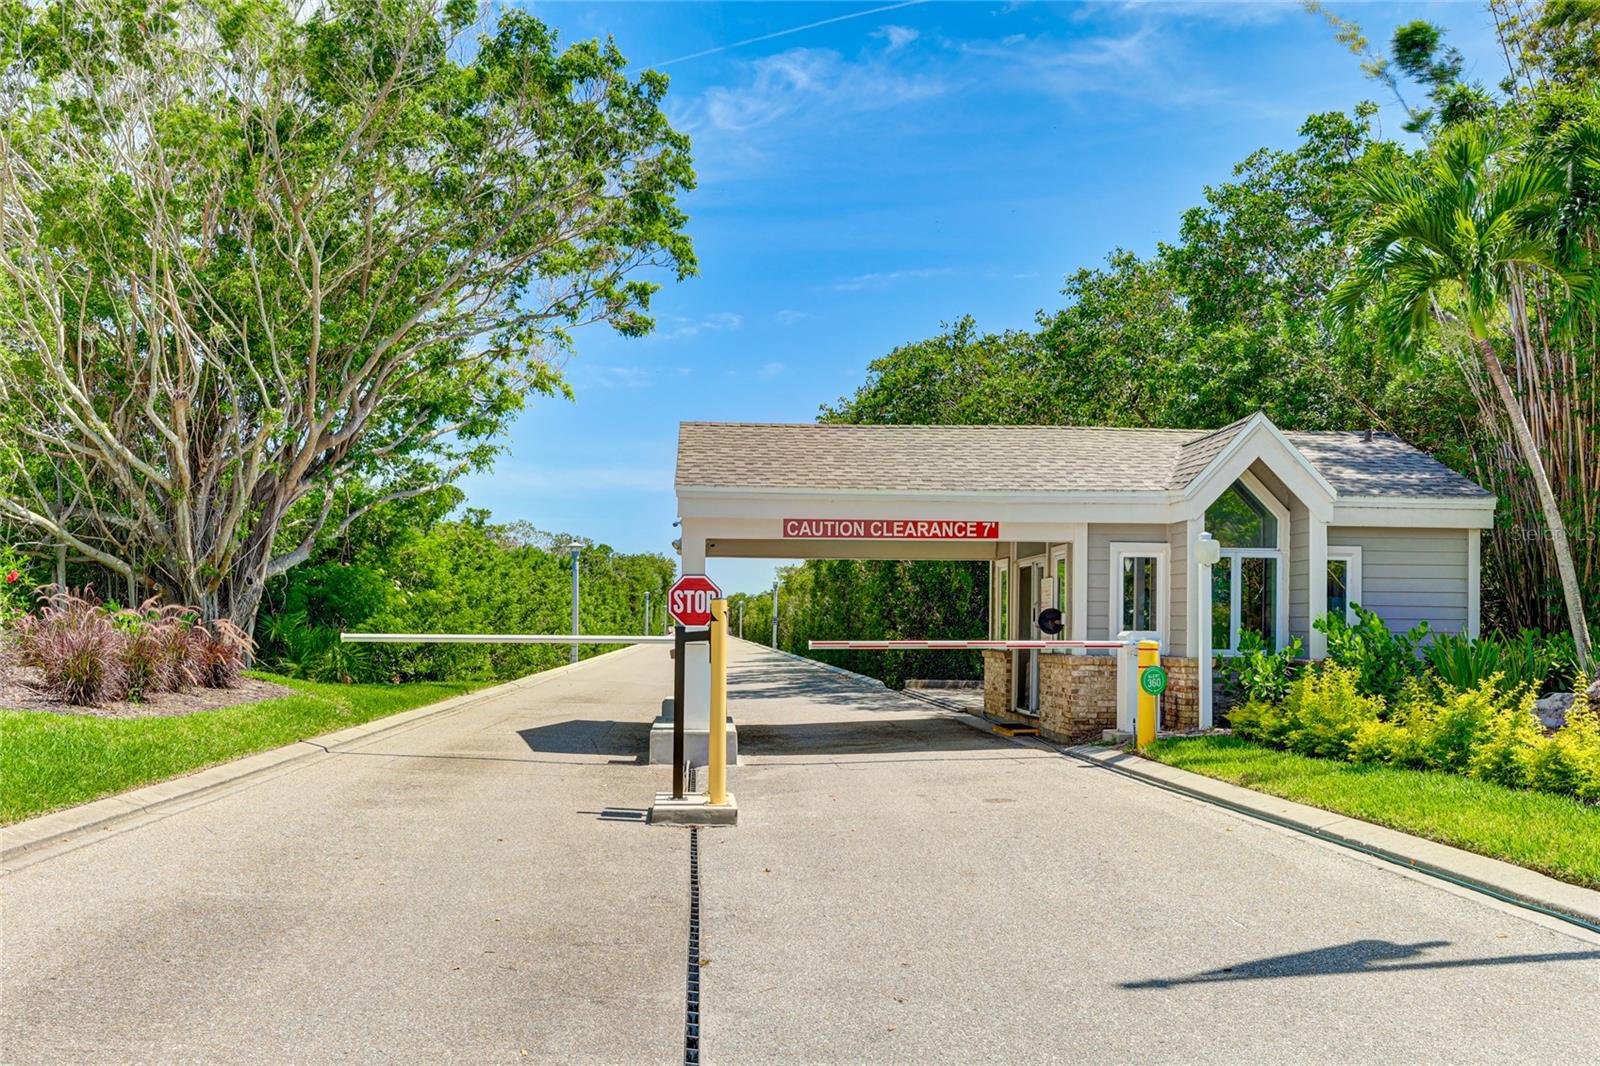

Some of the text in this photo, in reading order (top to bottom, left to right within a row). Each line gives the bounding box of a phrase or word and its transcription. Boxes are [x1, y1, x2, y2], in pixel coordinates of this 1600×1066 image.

[786, 521, 996, 537] CAUTION CLEARANCE 7'
[673, 590, 716, 614] STOP
[1147, 678, 1161, 688] 360
